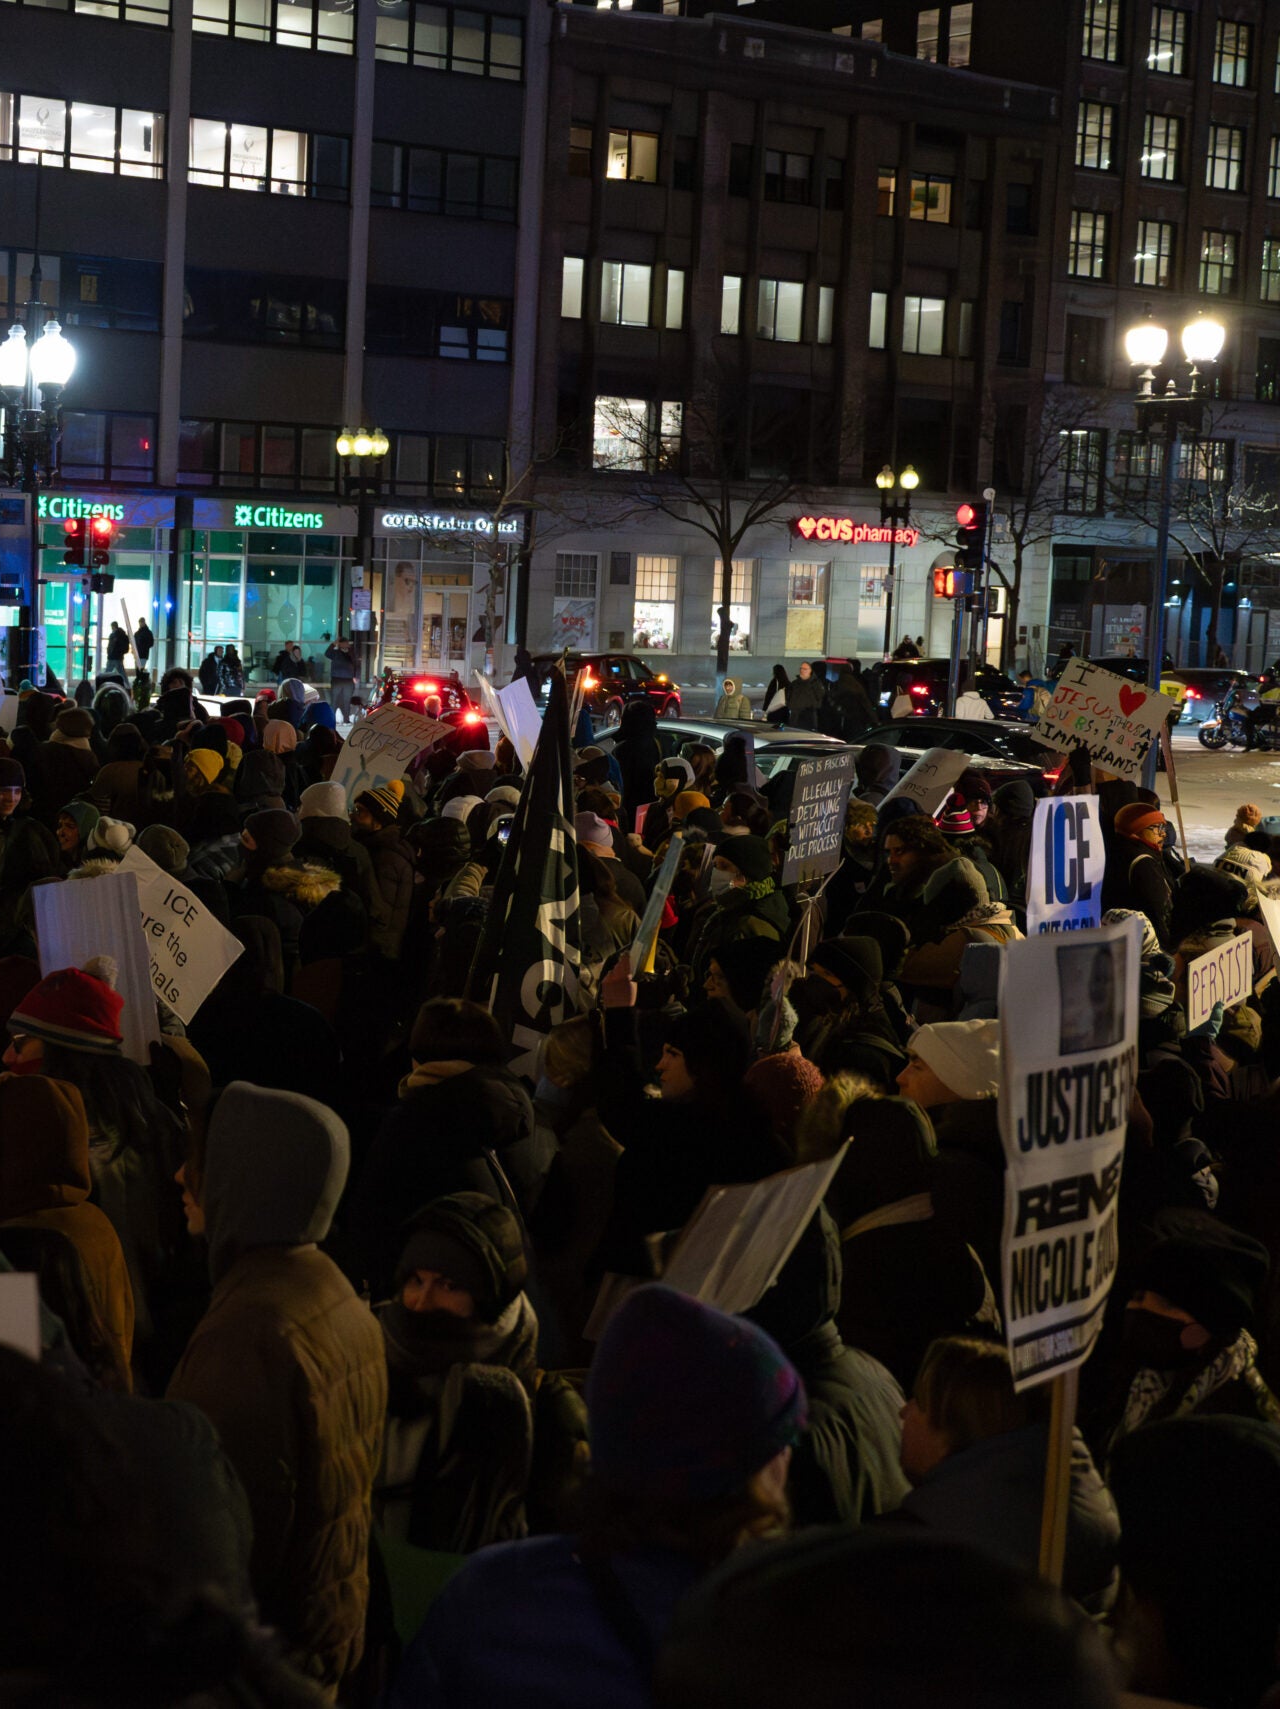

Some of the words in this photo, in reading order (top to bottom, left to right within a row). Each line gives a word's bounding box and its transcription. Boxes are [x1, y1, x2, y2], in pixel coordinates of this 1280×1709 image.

[48, 497, 125, 520] Citizens
[253, 506, 323, 529] Citizens
[815, 516, 854, 541] CVS
[824, 753, 851, 771] FASCISM
[801, 777, 844, 802] ILLEGALLY
[796, 795, 841, 824] DETAINING
[798, 813, 838, 841] WITHOUT
[787, 842, 805, 862] DUE
[807, 832, 841, 857] PROCESS
[1044, 801, 1093, 905] ICE
[163, 889, 199, 928] ICE
[140, 911, 165, 937] re
[166, 931, 188, 968] the
[1192, 937, 1250, 1020] PERSIST
[1018, 1057, 1118, 1153] JUSTICE
[1011, 1229, 1095, 1322] NICOLE
